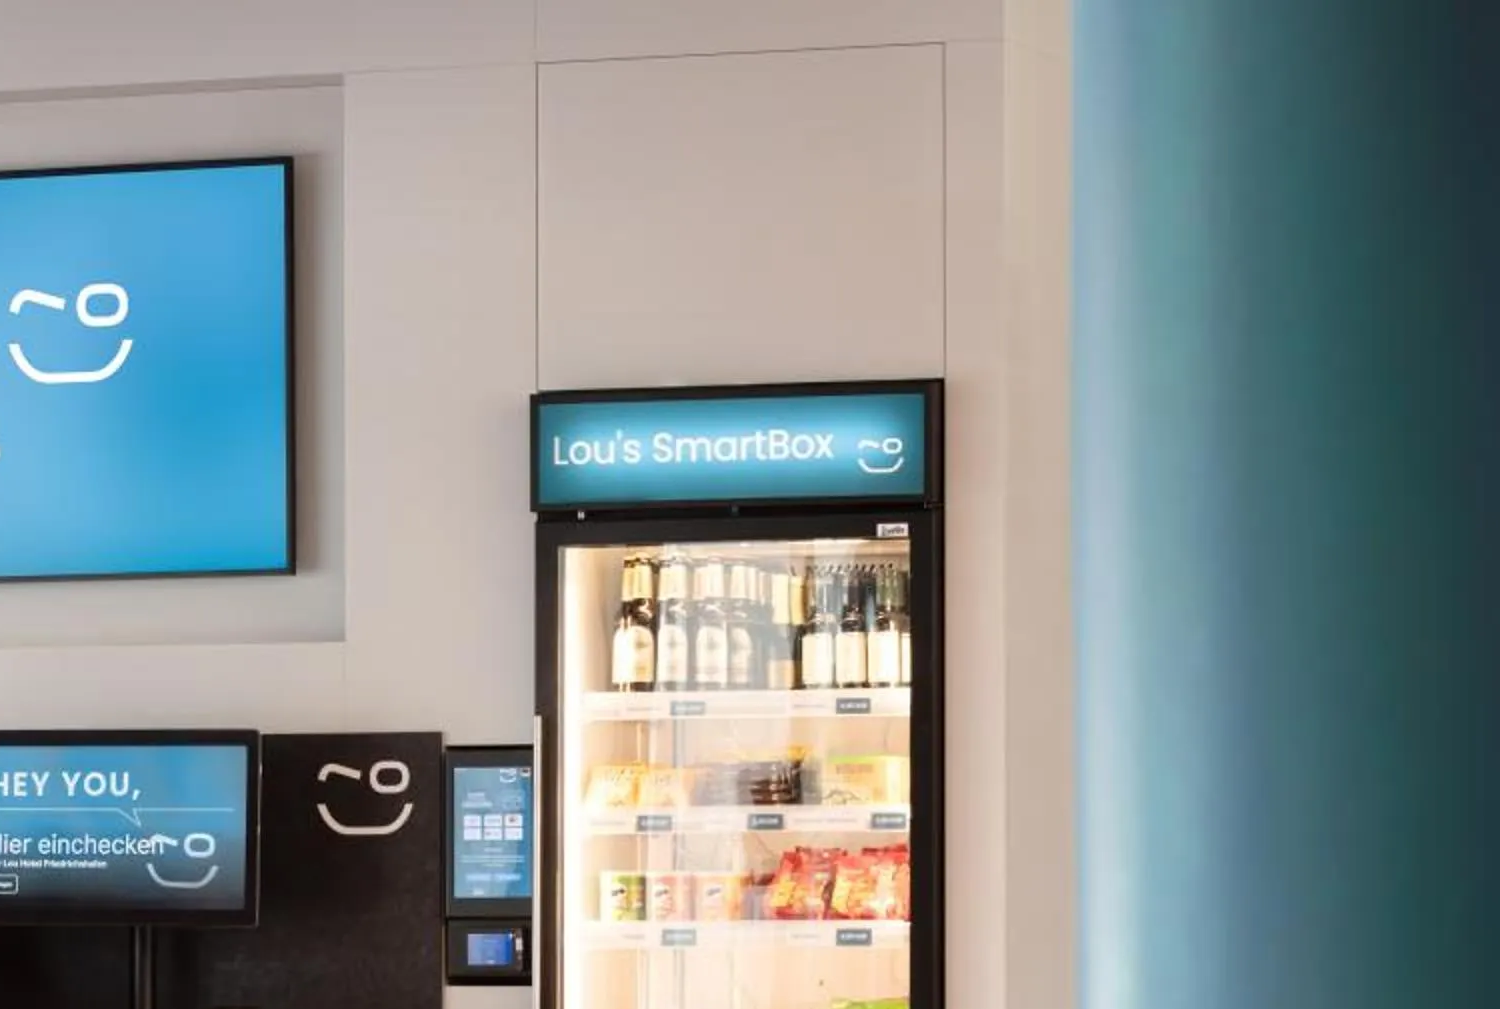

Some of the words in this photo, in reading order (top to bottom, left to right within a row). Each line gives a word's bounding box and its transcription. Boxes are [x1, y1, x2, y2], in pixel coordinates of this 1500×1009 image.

[553, 430, 641, 466] Lou's
[652, 429, 835, 463] SmartBox
[62, 771, 142, 801] YOU,
[38, 833, 164, 855] einchecken
